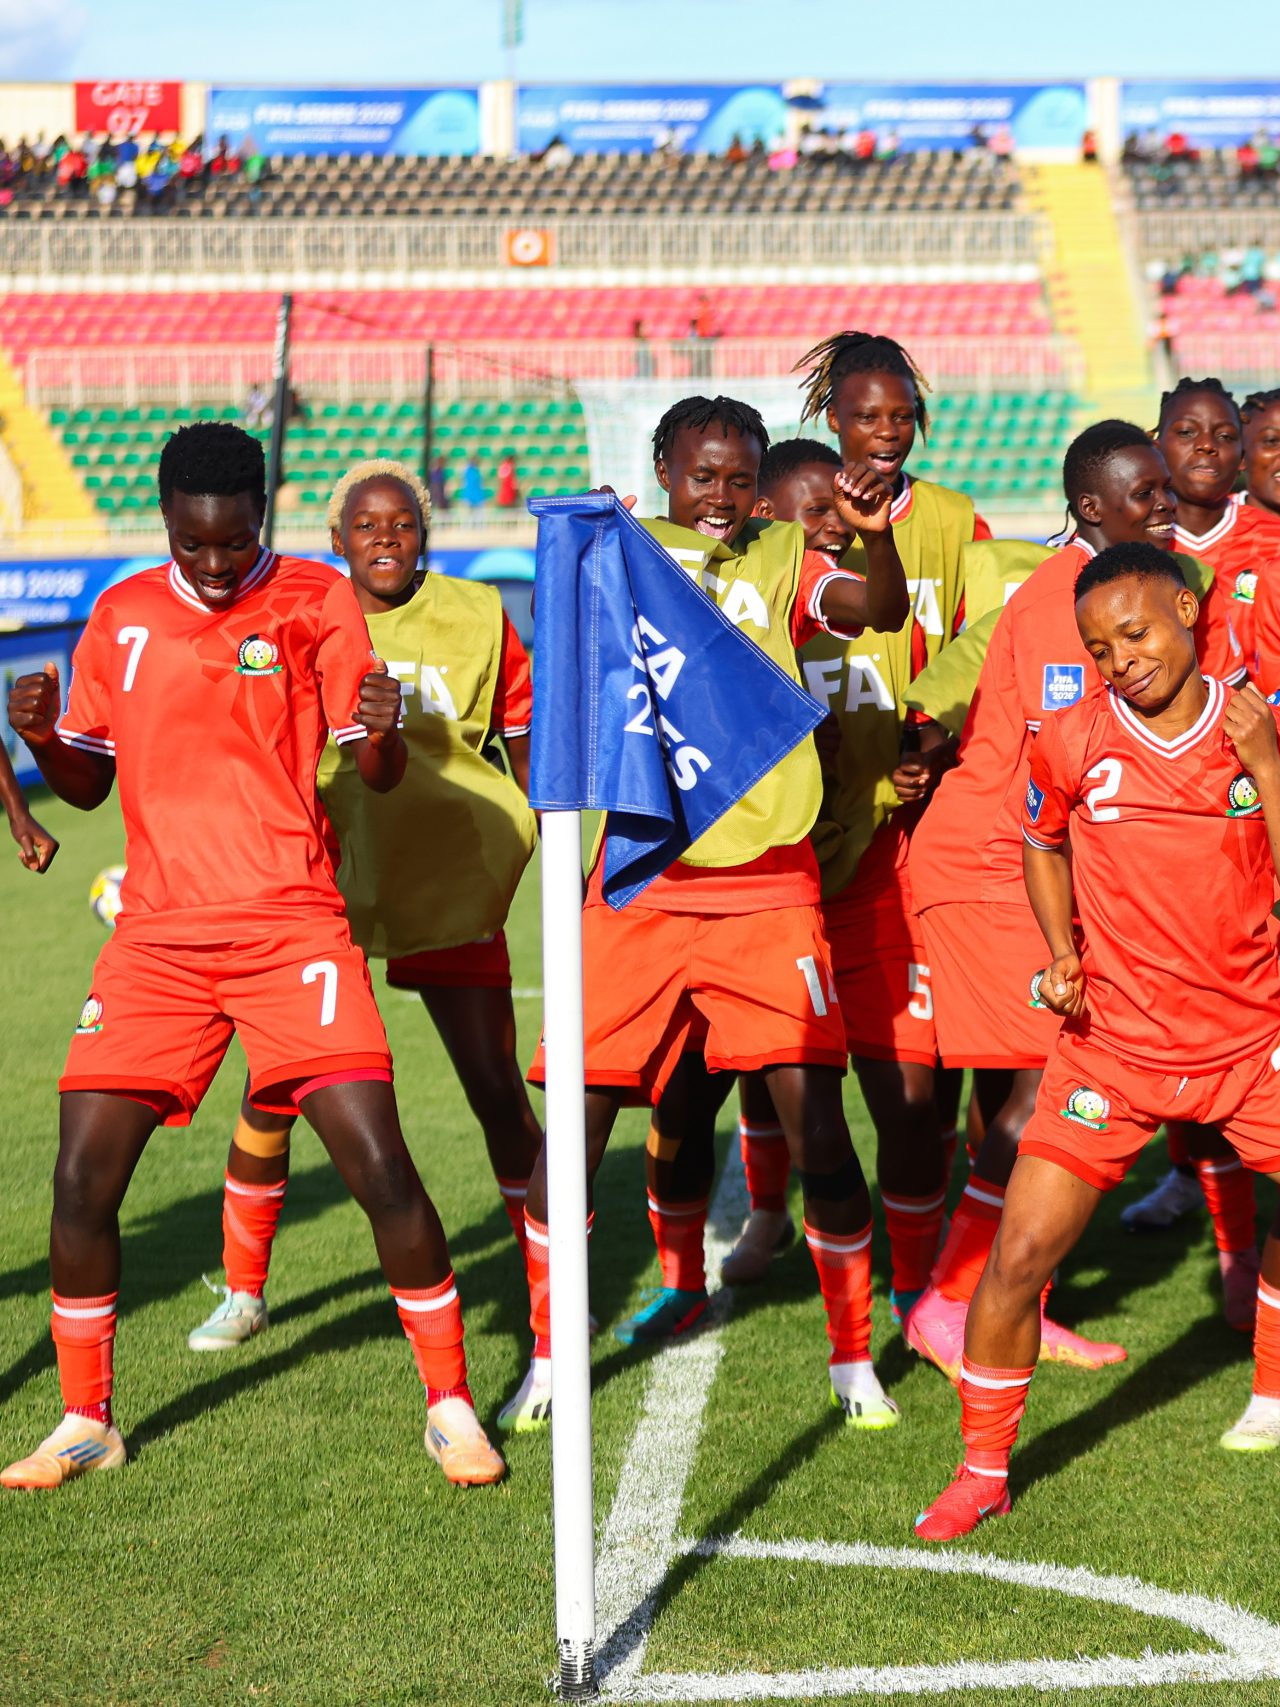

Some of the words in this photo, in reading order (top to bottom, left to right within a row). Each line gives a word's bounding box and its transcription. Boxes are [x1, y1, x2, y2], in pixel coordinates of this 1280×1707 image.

[91, 83, 163, 106] GATE
[117, 626, 149, 692] 7
[631, 615, 686, 701] FA
[803, 655, 896, 712] FA
[1053, 675, 1074, 684] FIFA
[387, 662, 458, 721] FA
[1048, 683, 1079, 692] SERIES
[1052, 691, 1076, 700] 2026
[1086, 758, 1123, 822] 2
[302, 961, 338, 1026] 7
[908, 963, 933, 1020] 5
